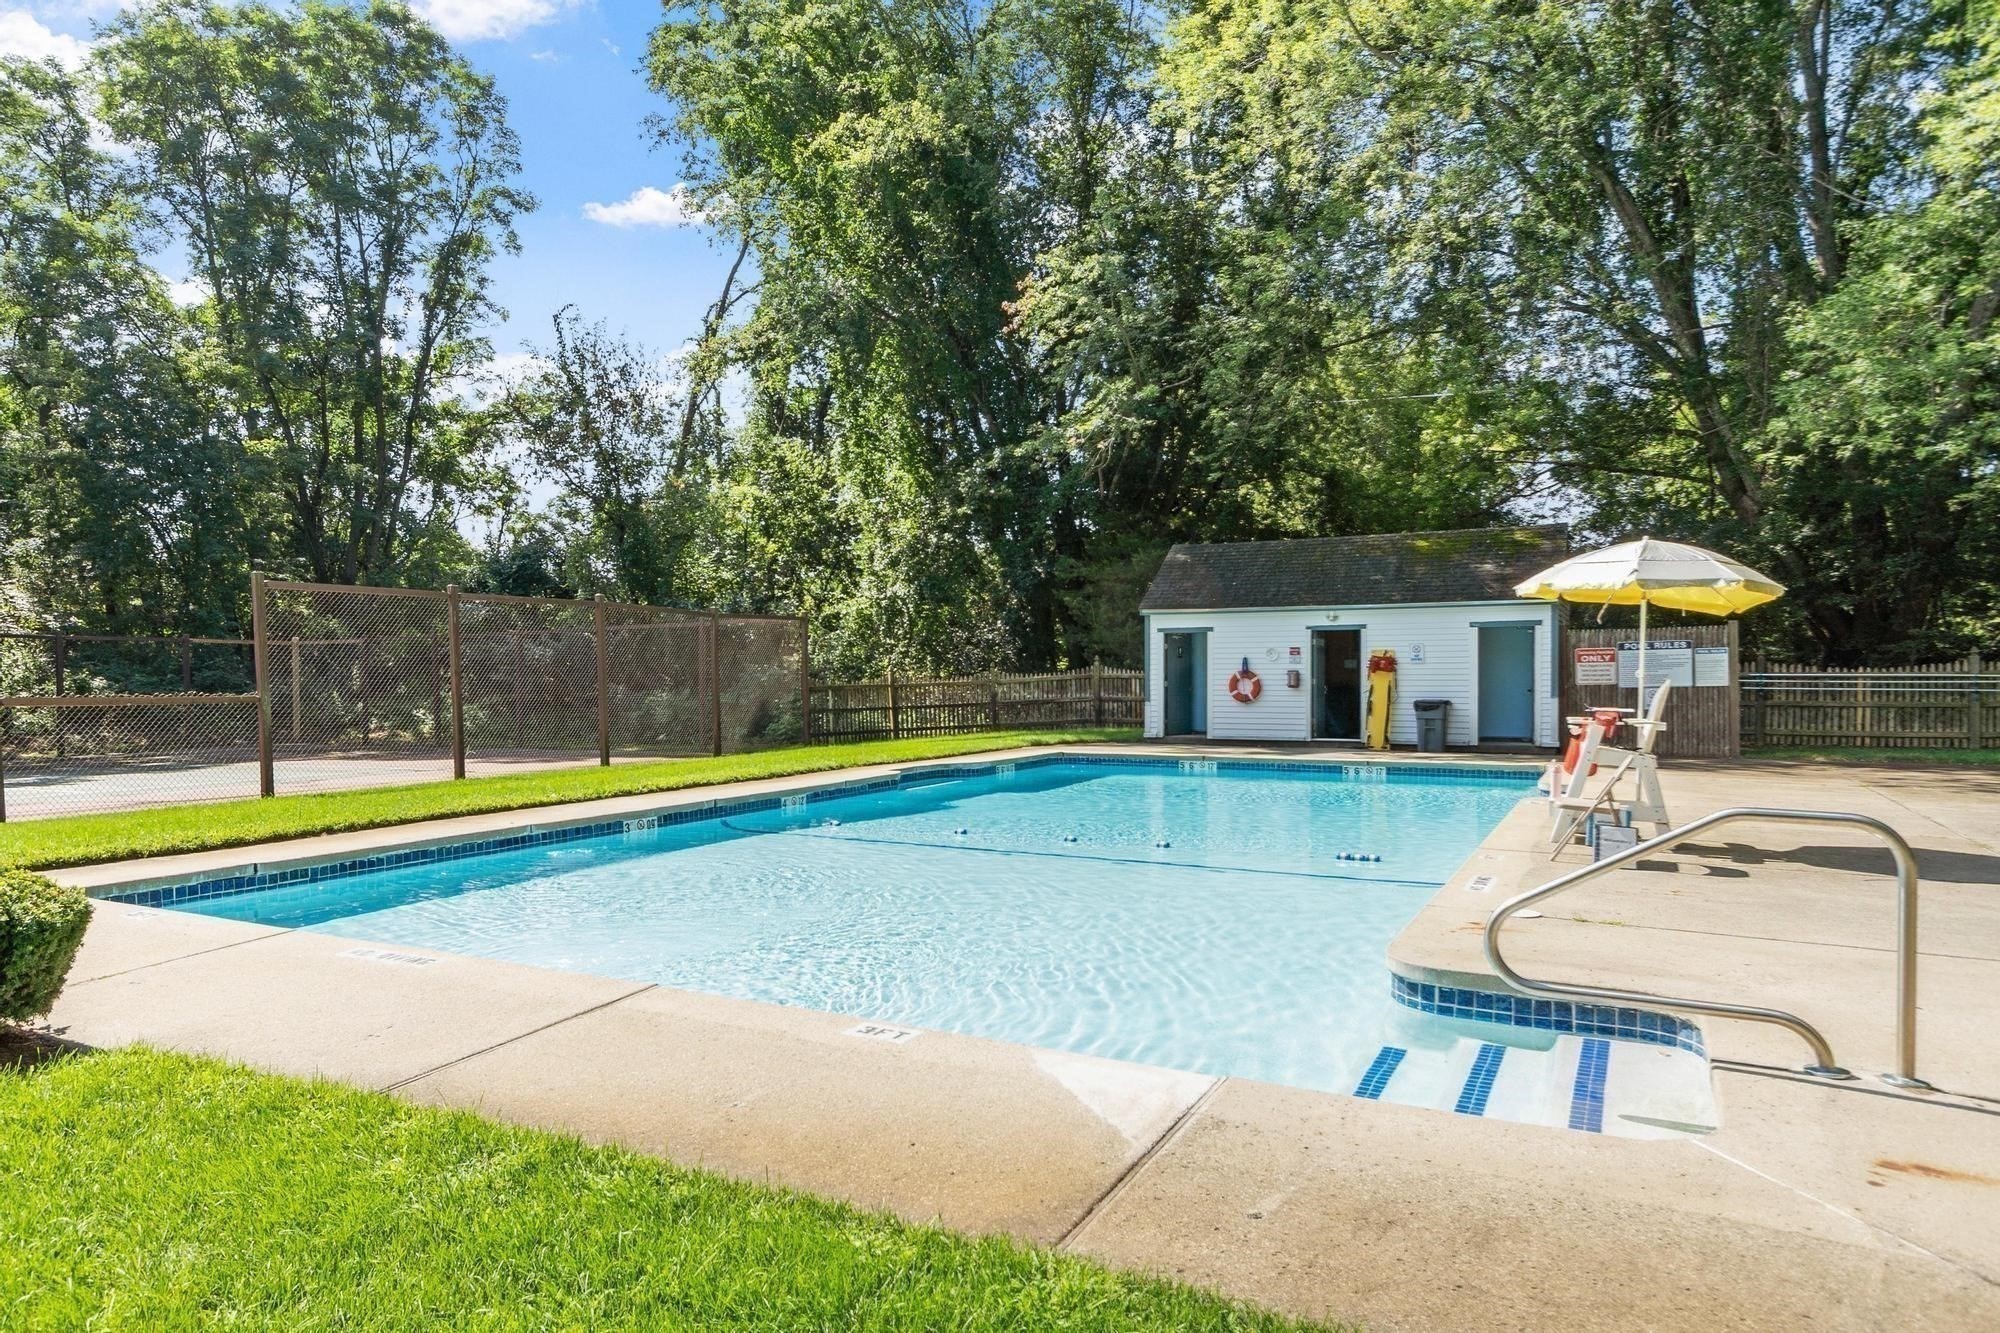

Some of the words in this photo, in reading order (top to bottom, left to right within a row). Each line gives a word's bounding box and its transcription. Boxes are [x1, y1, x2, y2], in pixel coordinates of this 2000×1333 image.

[1624, 642, 1650, 650] POL
[1654, 641, 1687, 649] RULES
[624, 822, 630, 833] 3
